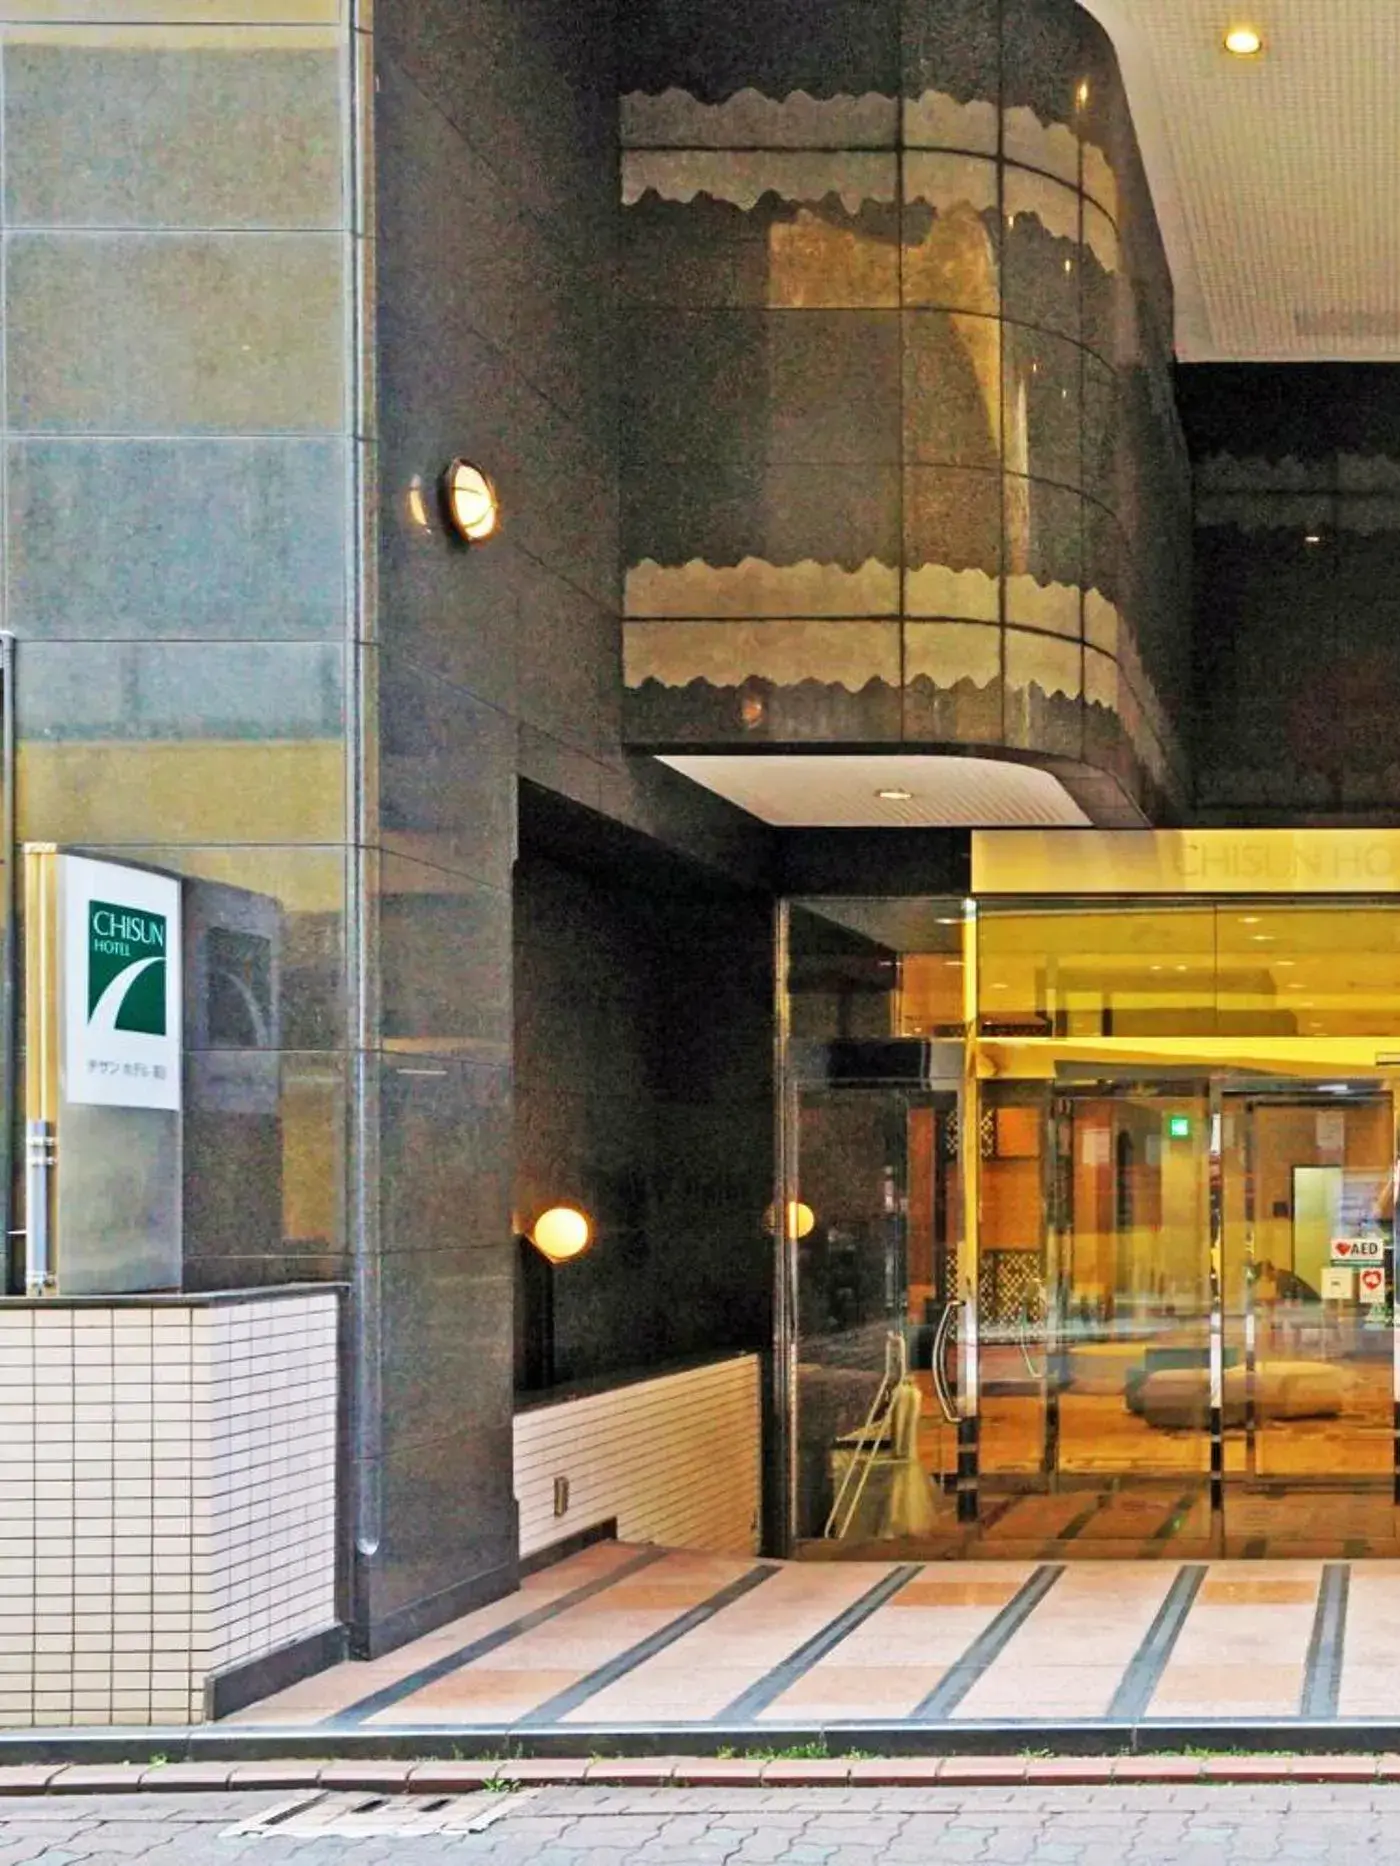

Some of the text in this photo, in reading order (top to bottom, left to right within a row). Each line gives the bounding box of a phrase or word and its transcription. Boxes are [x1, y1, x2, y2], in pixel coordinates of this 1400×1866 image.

[1172, 842, 1322, 877] CHISUN
[93, 910, 164, 947] CHISUN
[94, 938, 131, 957] HOTEL
[1350, 1242, 1379, 1256] AED
